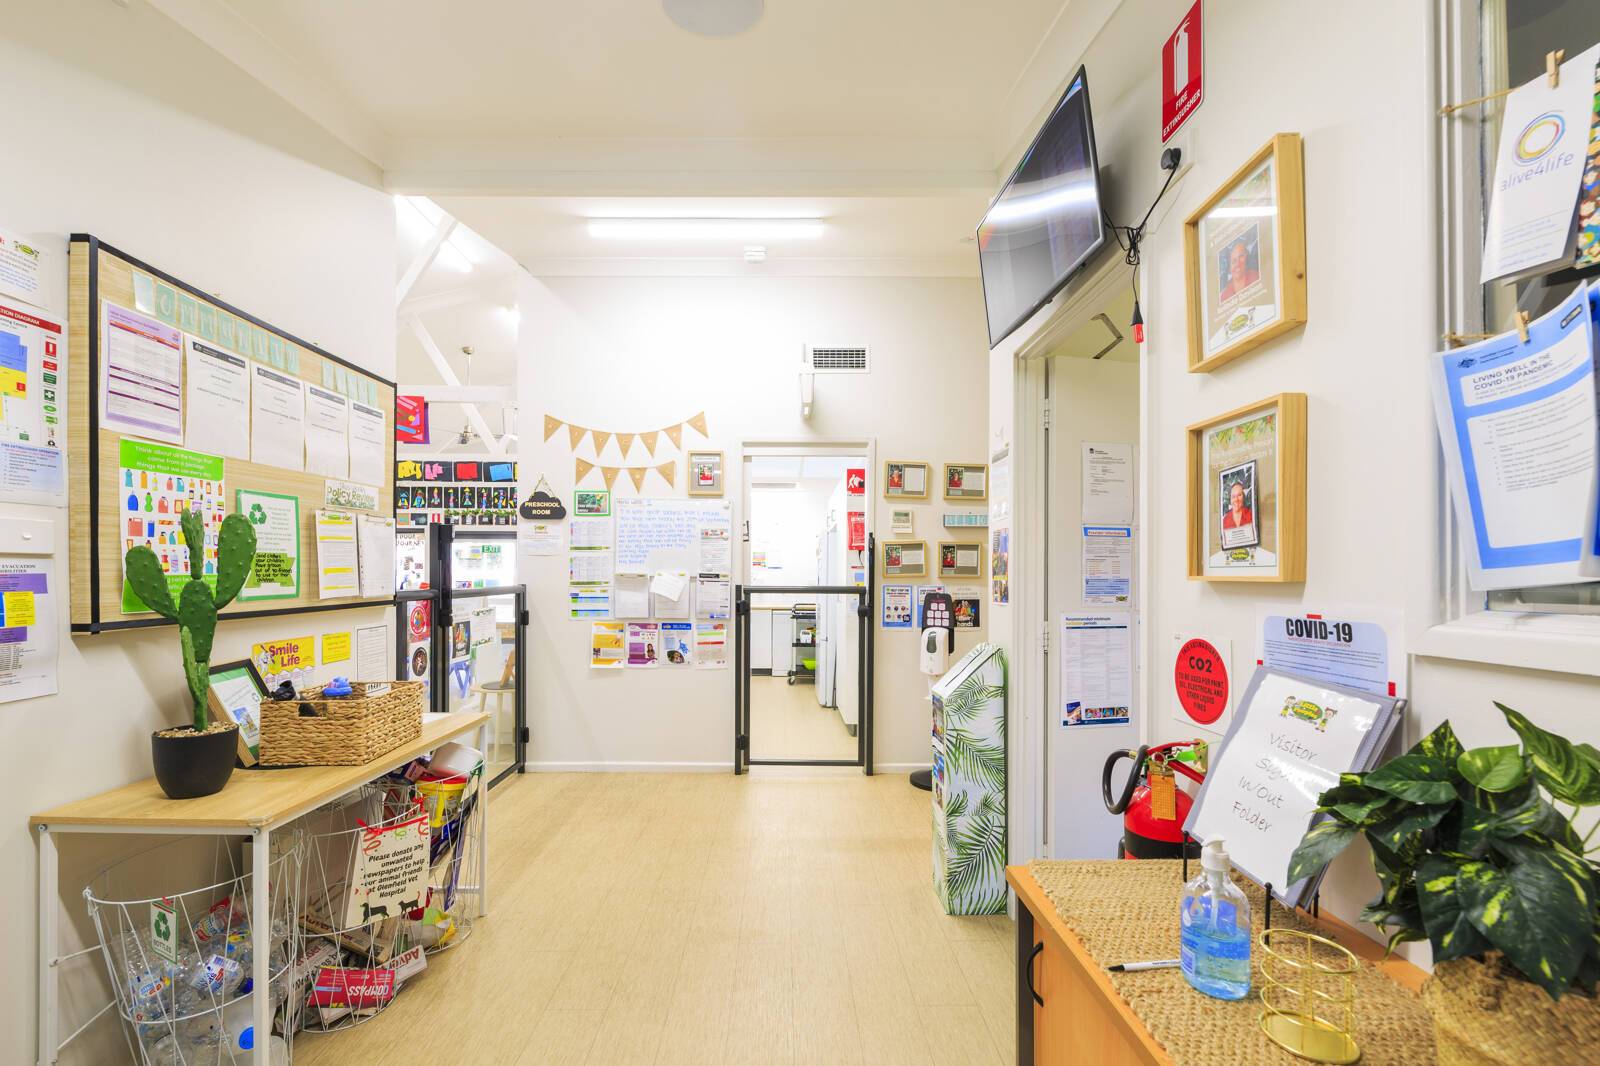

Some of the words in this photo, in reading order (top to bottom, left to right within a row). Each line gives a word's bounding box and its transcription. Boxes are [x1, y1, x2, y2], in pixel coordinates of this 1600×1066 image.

[1175, 90, 1189, 110] FIRE
[1162, 88, 1201, 137] EXTINGUISHER
[1500, 151, 1575, 192] alive4life
[1472, 371, 1503, 384] LIVING
[1504, 362, 1528, 376] WELL
[1474, 374, 1516, 391] COVID-19
[1516, 360, 1553, 380] PANDEMIC
[135, 445, 152, 454] Think
[1286, 618, 1353, 644] COVID-19
[268, 642, 299, 656] Smile
[281, 655, 300, 668] Life
[1189, 656, 1212, 672] CO2
[1188, 682, 1212, 695] ELECTRICAL
[1214, 689, 1223, 698] AND
[1232, 800, 1273, 833] Folder
[368, 852, 390, 863] Please
[391, 846, 413, 859] donate
[414, 842, 424, 852] any
[381, 854, 413, 868] unwanted
[412, 858, 426, 868] help
[368, 886, 376, 894] at
[376, 878, 408, 892] Glenfield
[408, 874, 418, 883] Vet
[378, 872, 401, 884] animal
[402, 866, 424, 878] friends
[379, 886, 407, 898] Hospital
[152, 938, 172, 954] BOTTLES
[390, 948, 420, 969] Adve
[348, 984, 389, 996] COMPASS
